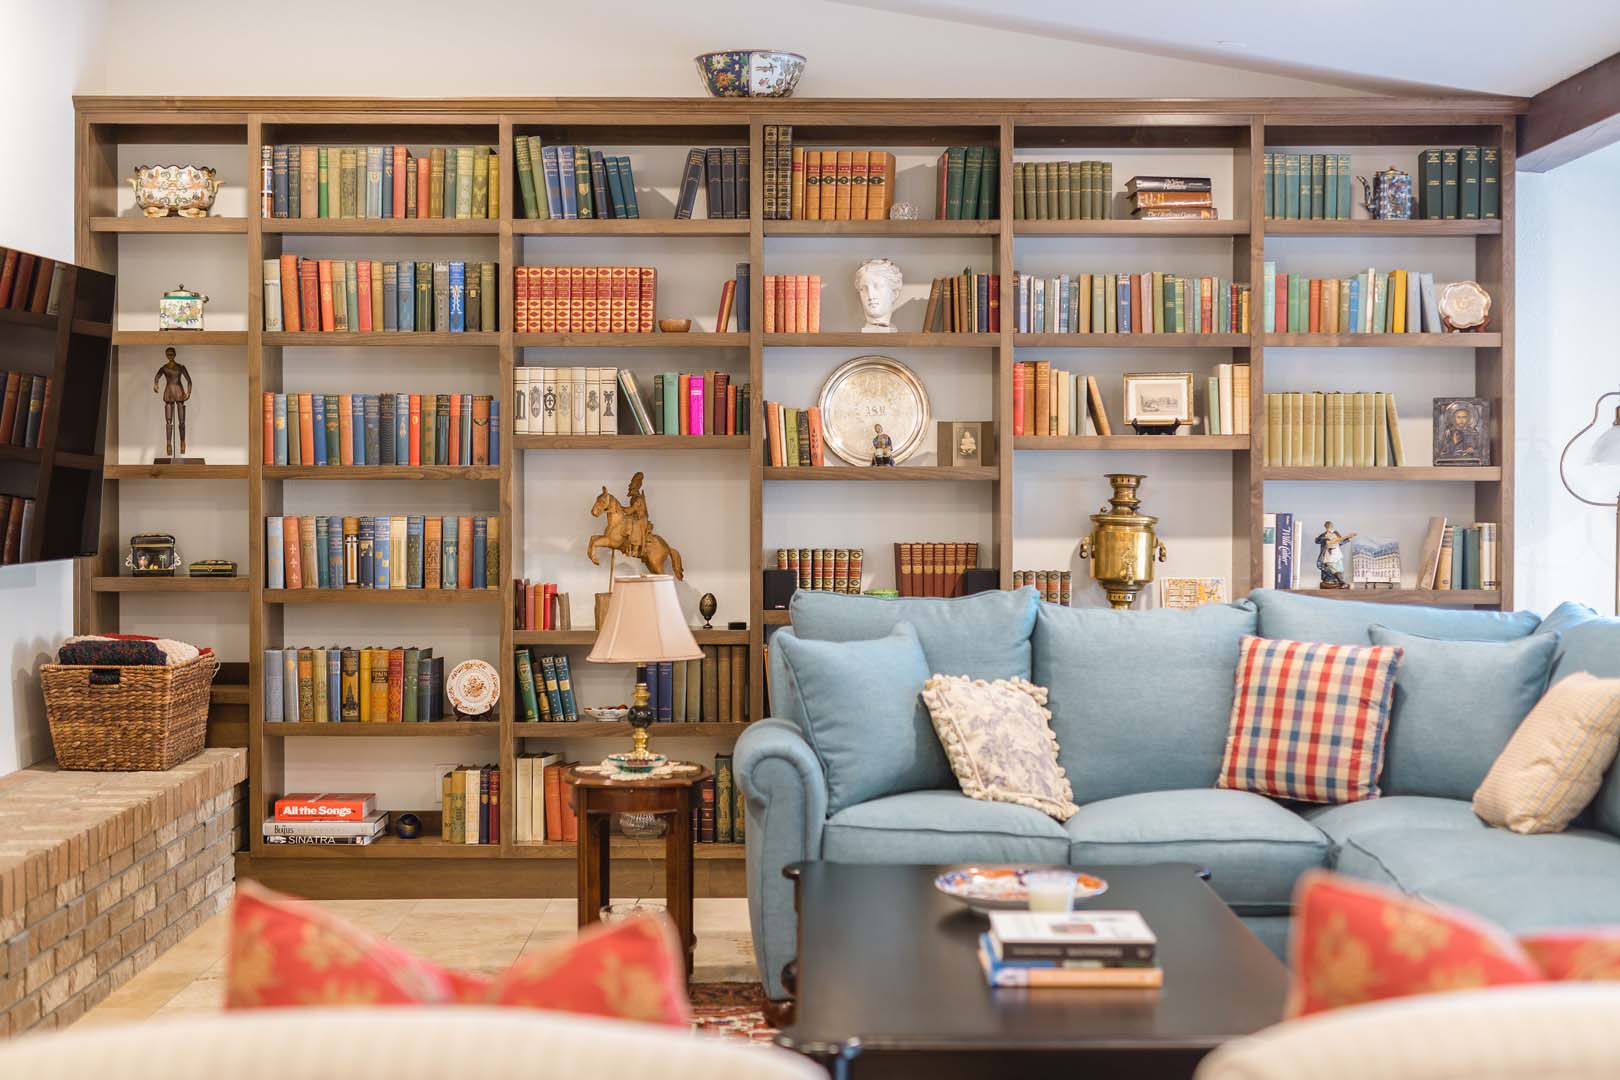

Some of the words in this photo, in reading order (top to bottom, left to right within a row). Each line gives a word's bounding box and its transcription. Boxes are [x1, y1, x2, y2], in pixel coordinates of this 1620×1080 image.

[282, 806, 300, 815] All
[299, 806, 318, 815] the
[318, 806, 352, 816] Songs
[287, 835, 336, 844] SINATRA
